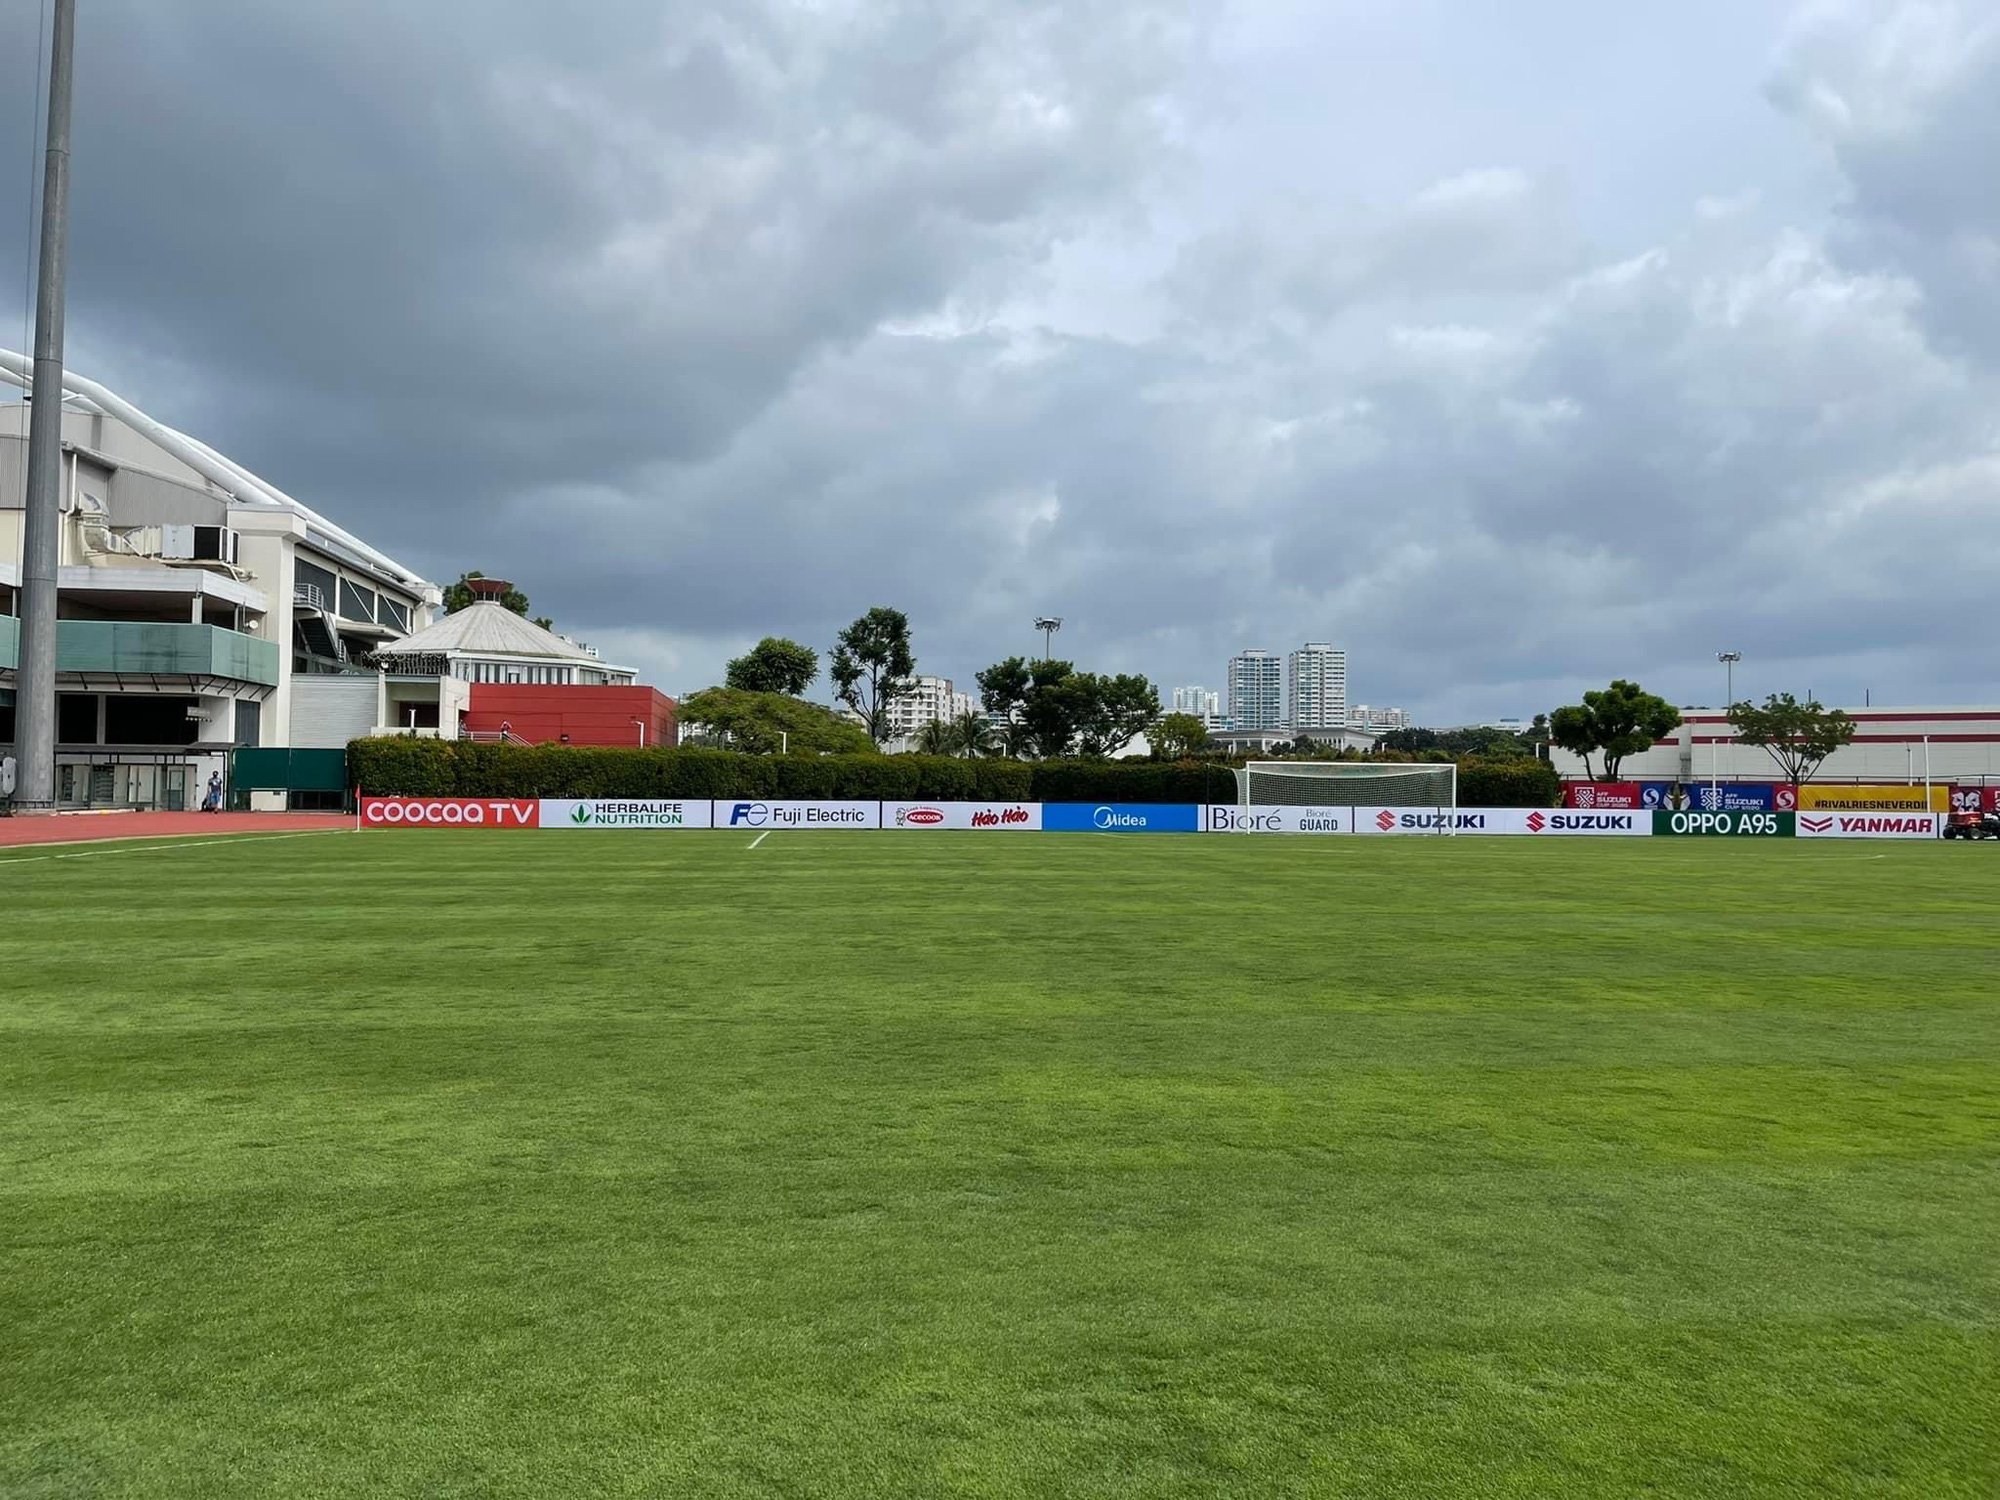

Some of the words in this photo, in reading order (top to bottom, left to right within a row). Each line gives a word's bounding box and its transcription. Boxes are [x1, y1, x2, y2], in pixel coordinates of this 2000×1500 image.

[488, 803, 534, 824] TV
[595, 803, 682, 813] HERBALIFE
[595, 814, 682, 824] NUTRITION
[773, 808, 801, 825] Fuji
[806, 808, 865, 822] Electric
[1104, 813, 1147, 826] Midea
[1212, 807, 1282, 831] Bioré
[1401, 814, 1485, 829] SUZUKI
[1550, 815, 1632, 829] SUZUKI
[1671, 813, 1732, 834] OPPO
[1737, 814, 1778, 834] A95
[1300, 819, 1338, 831] GUARD
[1838, 818, 1933, 833] YANMAR
